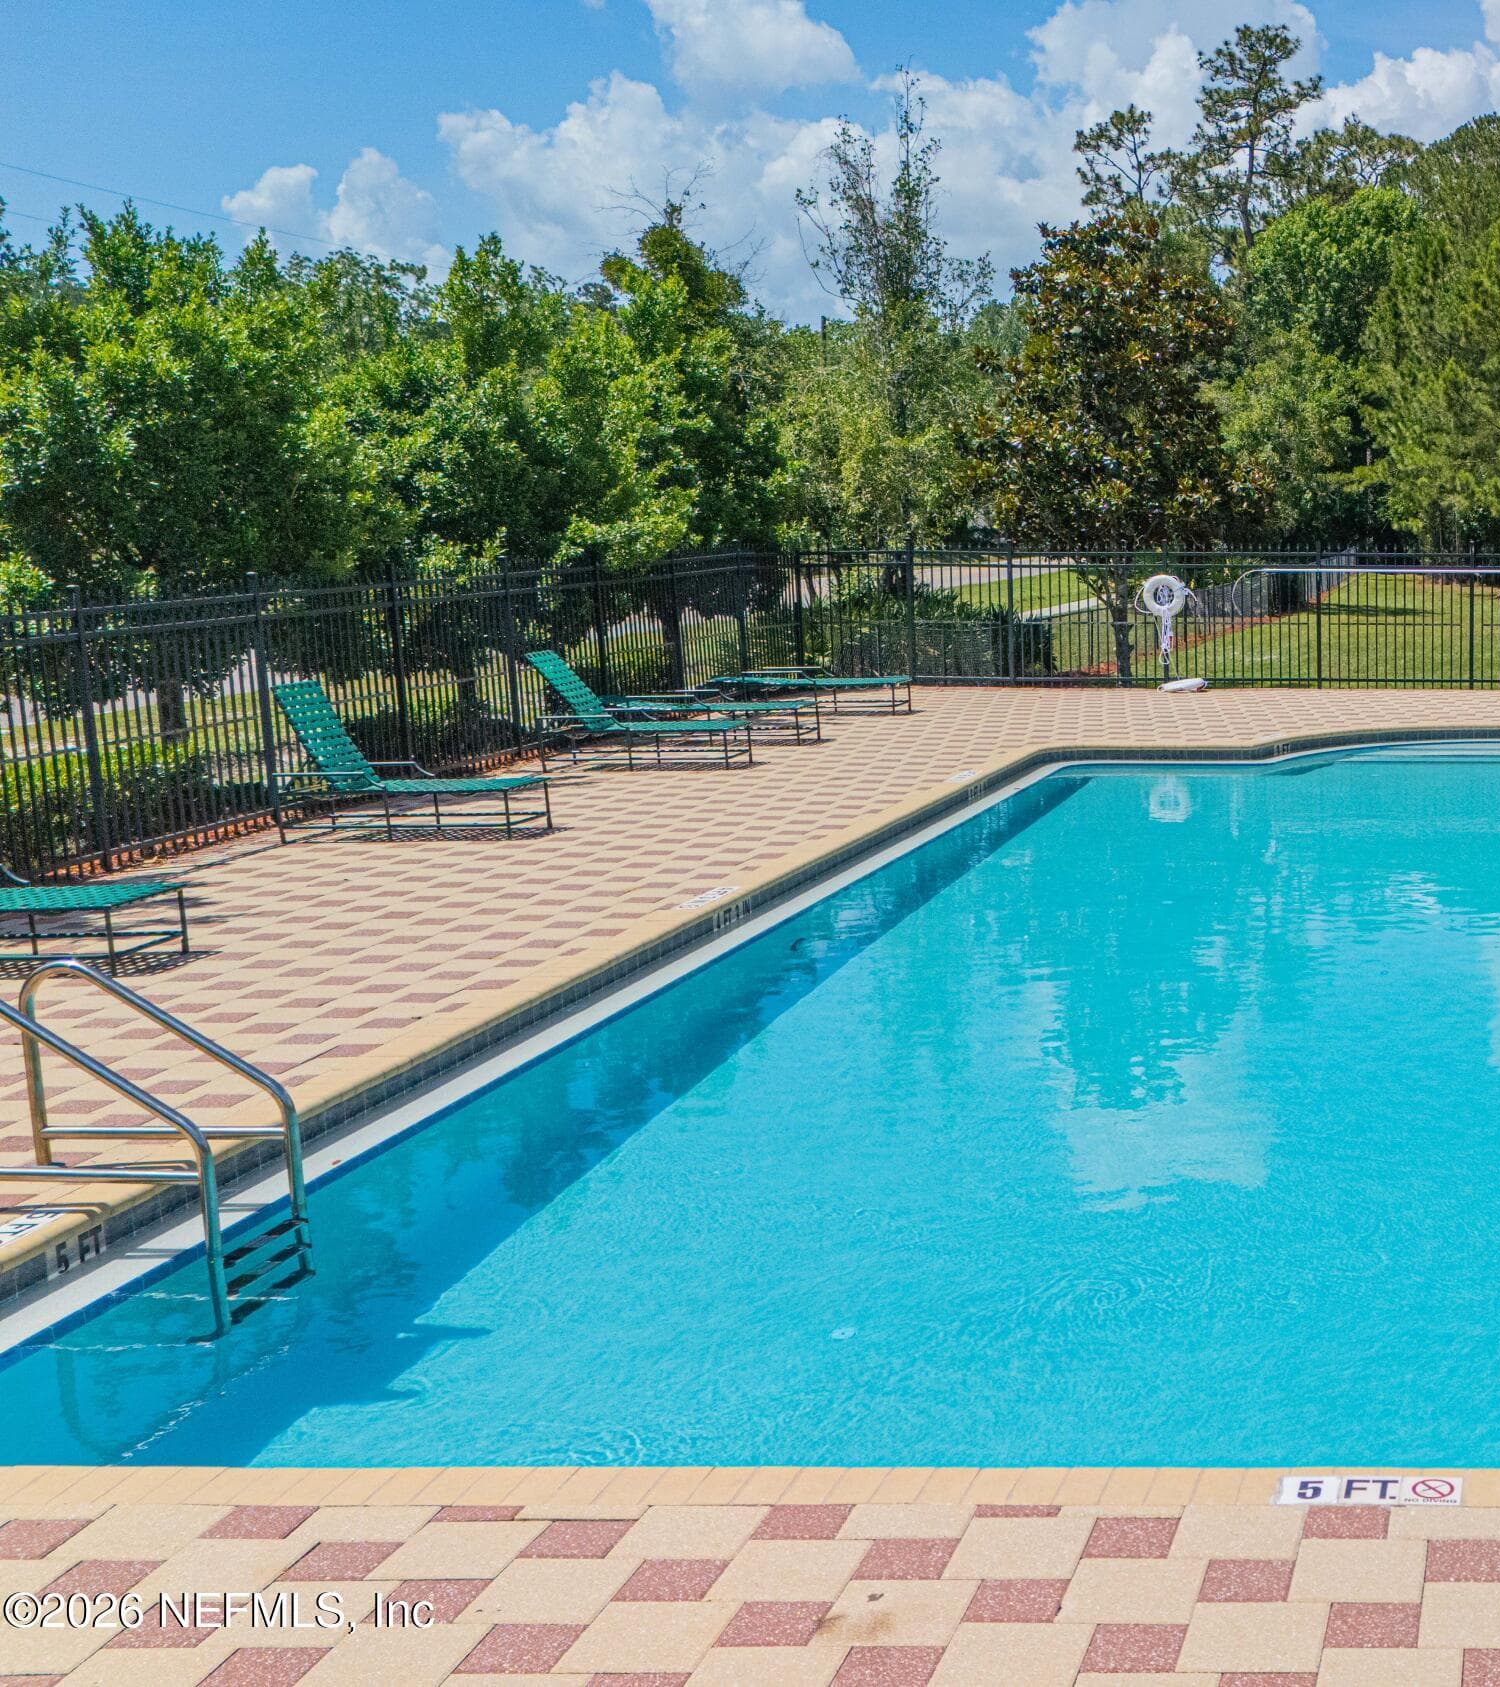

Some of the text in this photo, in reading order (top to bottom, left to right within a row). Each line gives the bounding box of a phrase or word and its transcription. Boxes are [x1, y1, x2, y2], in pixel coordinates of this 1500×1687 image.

[55, 1223, 102, 1274] 5 FT
[1297, 1479, 1399, 1500] 5 FT.
